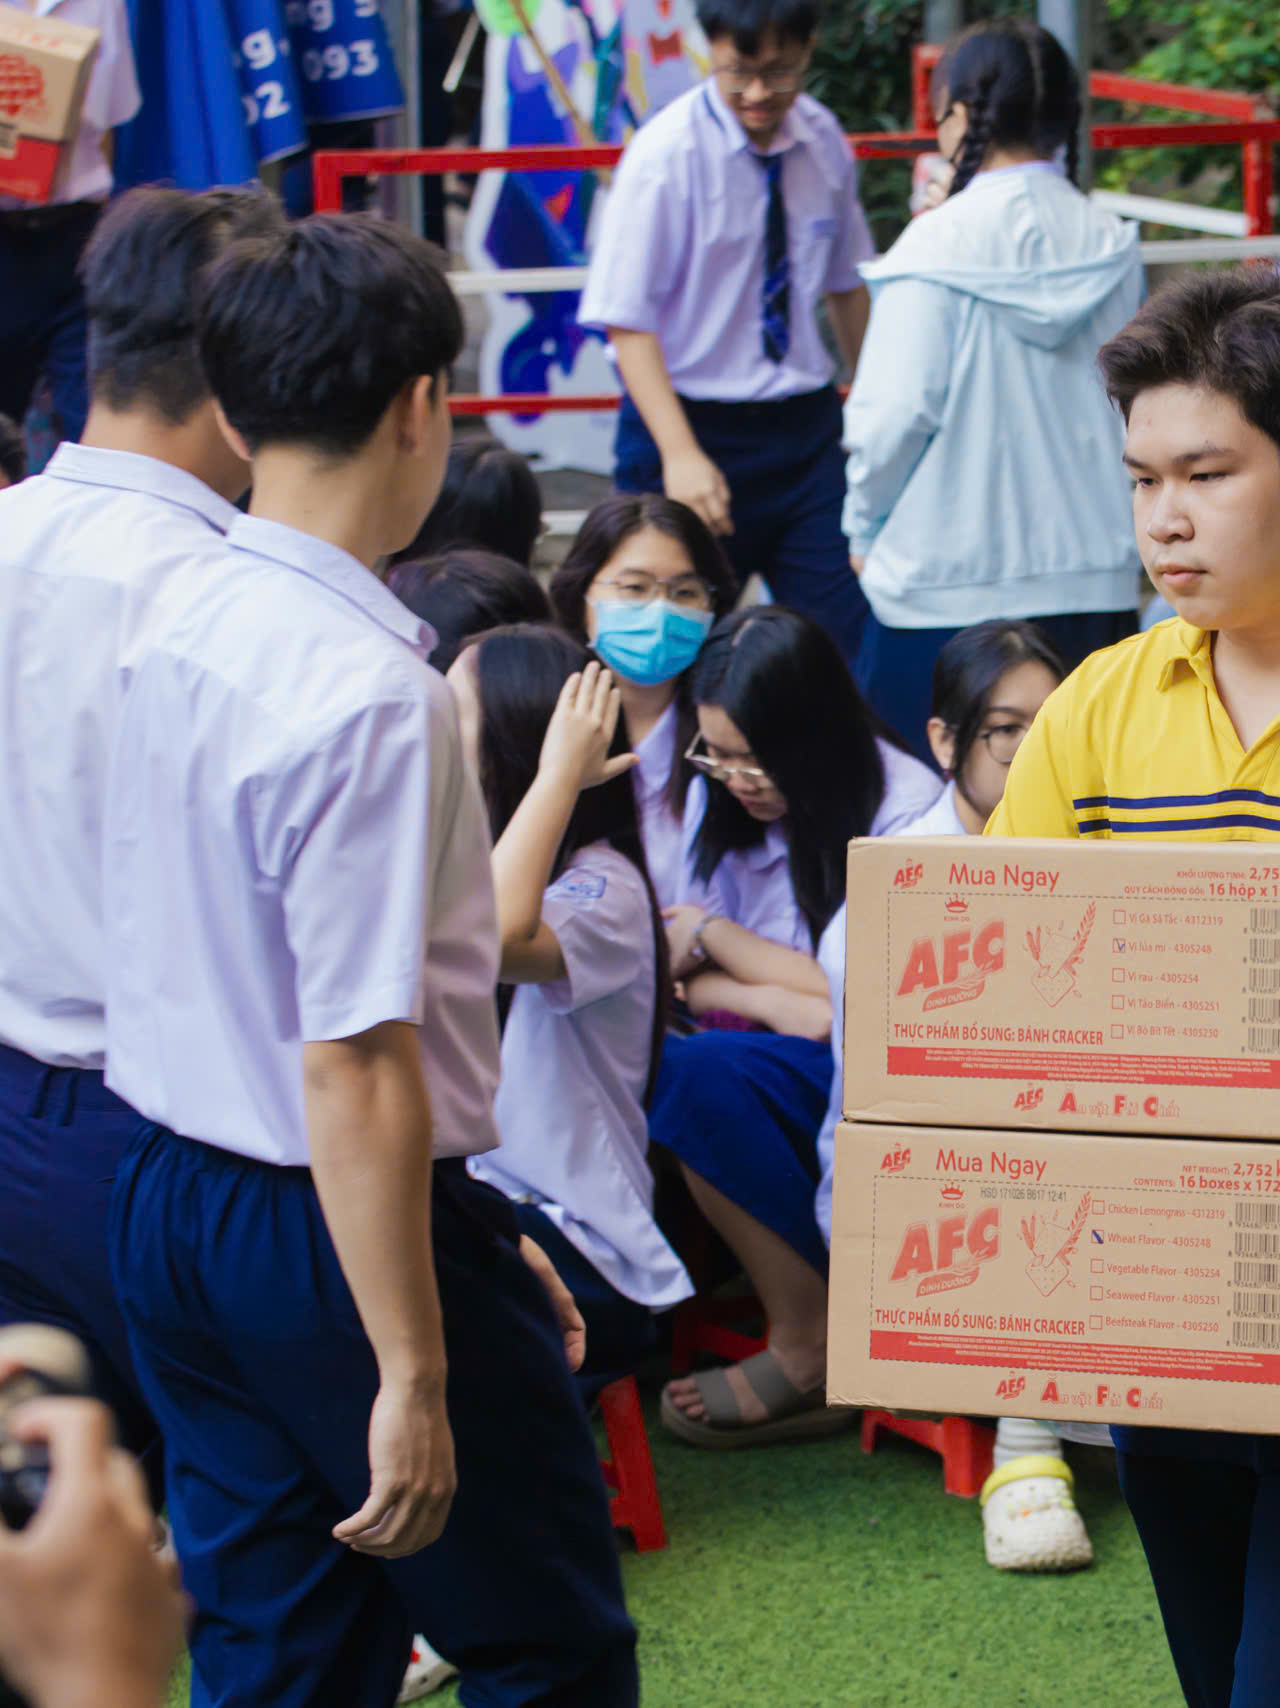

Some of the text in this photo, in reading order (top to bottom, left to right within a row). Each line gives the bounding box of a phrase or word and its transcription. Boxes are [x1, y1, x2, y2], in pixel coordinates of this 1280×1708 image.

[894, 864, 923, 886] AFC
[949, 863, 1060, 893] Mua Ngay
[1124, 885, 1140, 895] QUY
[1142, 883, 1162, 895] CÁCH
[1209, 883, 1224, 896] 16
[1229, 882, 1256, 900] hộp
[1260, 887, 1267, 897] x
[1185, 914, 1224, 926] 4312319
[897, 918, 1005, 996] AFC
[1174, 943, 1212, 954] 4305248
[1139, 974, 1152, 982] rau
[1161, 973, 1199, 984] 4305254
[1183, 1001, 1220, 1012] 4305251
[894, 1022, 925, 1042] THỰC
[926, 1019, 960, 1039] PHẨM
[980, 1027, 1016, 1042] SUNG:
[1018, 1026, 1050, 1042] BÁNH
[1052, 1029, 1104, 1046] CRACKER
[1183, 1027, 1219, 1039] 4305250
[1014, 1088, 1043, 1108] AFC
[880, 1148, 911, 1170] AFC
[936, 1149, 1047, 1181] Mua Ngay
[1182, 1165, 1197, 1174] NET
[1198, 1166, 1230, 1175] WEIGHT:
[1233, 1163, 1272, 1177] 2,752
[1133, 1177, 1174, 1187] CONTENTS:
[1180, 1176, 1195, 1188] 16
[1200, 1176, 1240, 1190] boxes
[1244, 1181, 1251, 1191] x
[1257, 1180, 1280, 1192] 172
[1108, 1204, 1225, 1219] Chicken Lemongrass 4312319
[890, 1207, 1000, 1281] AFC
[1108, 1233, 1211, 1248] Wheat Flavor 4305248
[1107, 1264, 1220, 1278] Vegetable Flavor 4305254
[1106, 1290, 1220, 1304] Seaweed Flavor 4305251
[876, 1308, 906, 1328] THỰC
[908, 1306, 941, 1326] PHẨM
[963, 1313, 998, 1330] SUNG:
[1000, 1313, 1032, 1331] BÁNH
[1033, 1319, 1085, 1335] CRACKER
[1105, 1316, 1219, 1333] Beefsteak Flavor 4305250
[995, 1376, 1025, 1397] AFC
